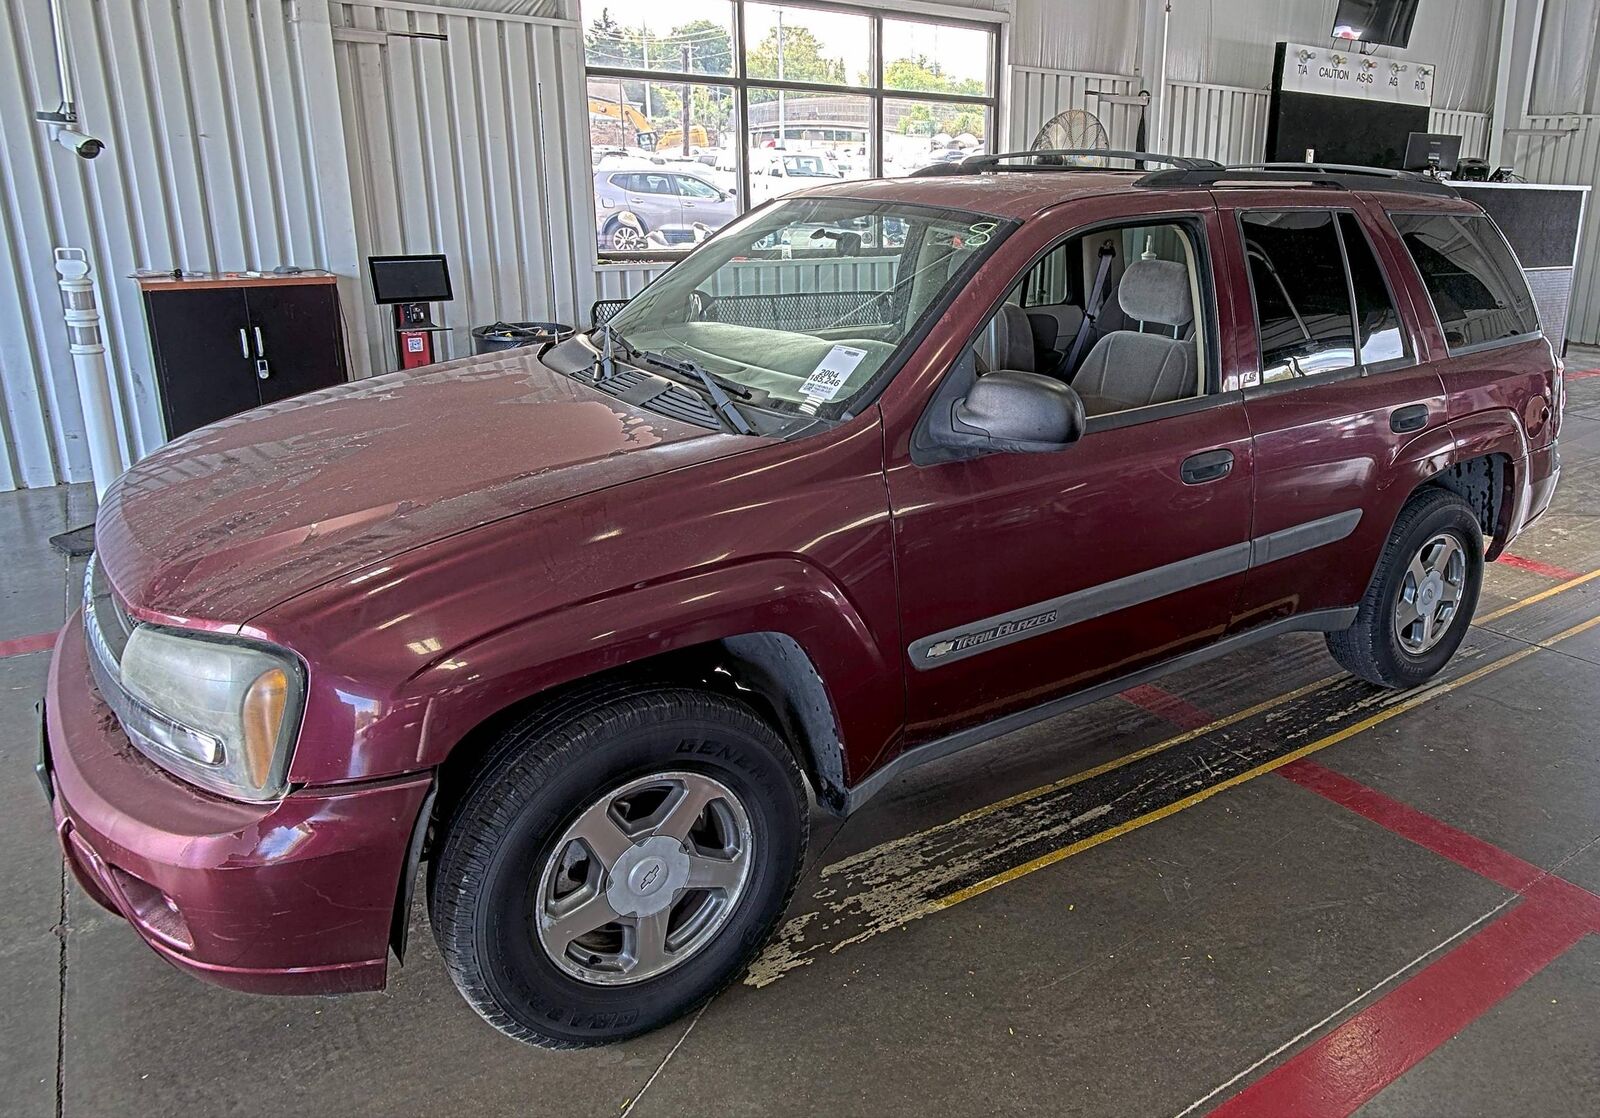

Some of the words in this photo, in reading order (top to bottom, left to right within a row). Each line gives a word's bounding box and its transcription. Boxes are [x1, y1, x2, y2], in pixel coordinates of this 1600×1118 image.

[1297, 64, 1308, 75] T/A
[1319, 67, 1350, 81] CAUTION
[1389, 77, 1399, 87] AG
[965, 222, 997, 246] 8
[819, 369, 840, 379] 2004
[1242, 372, 1257, 384] LS
[809, 374, 841, 387] 185,246
